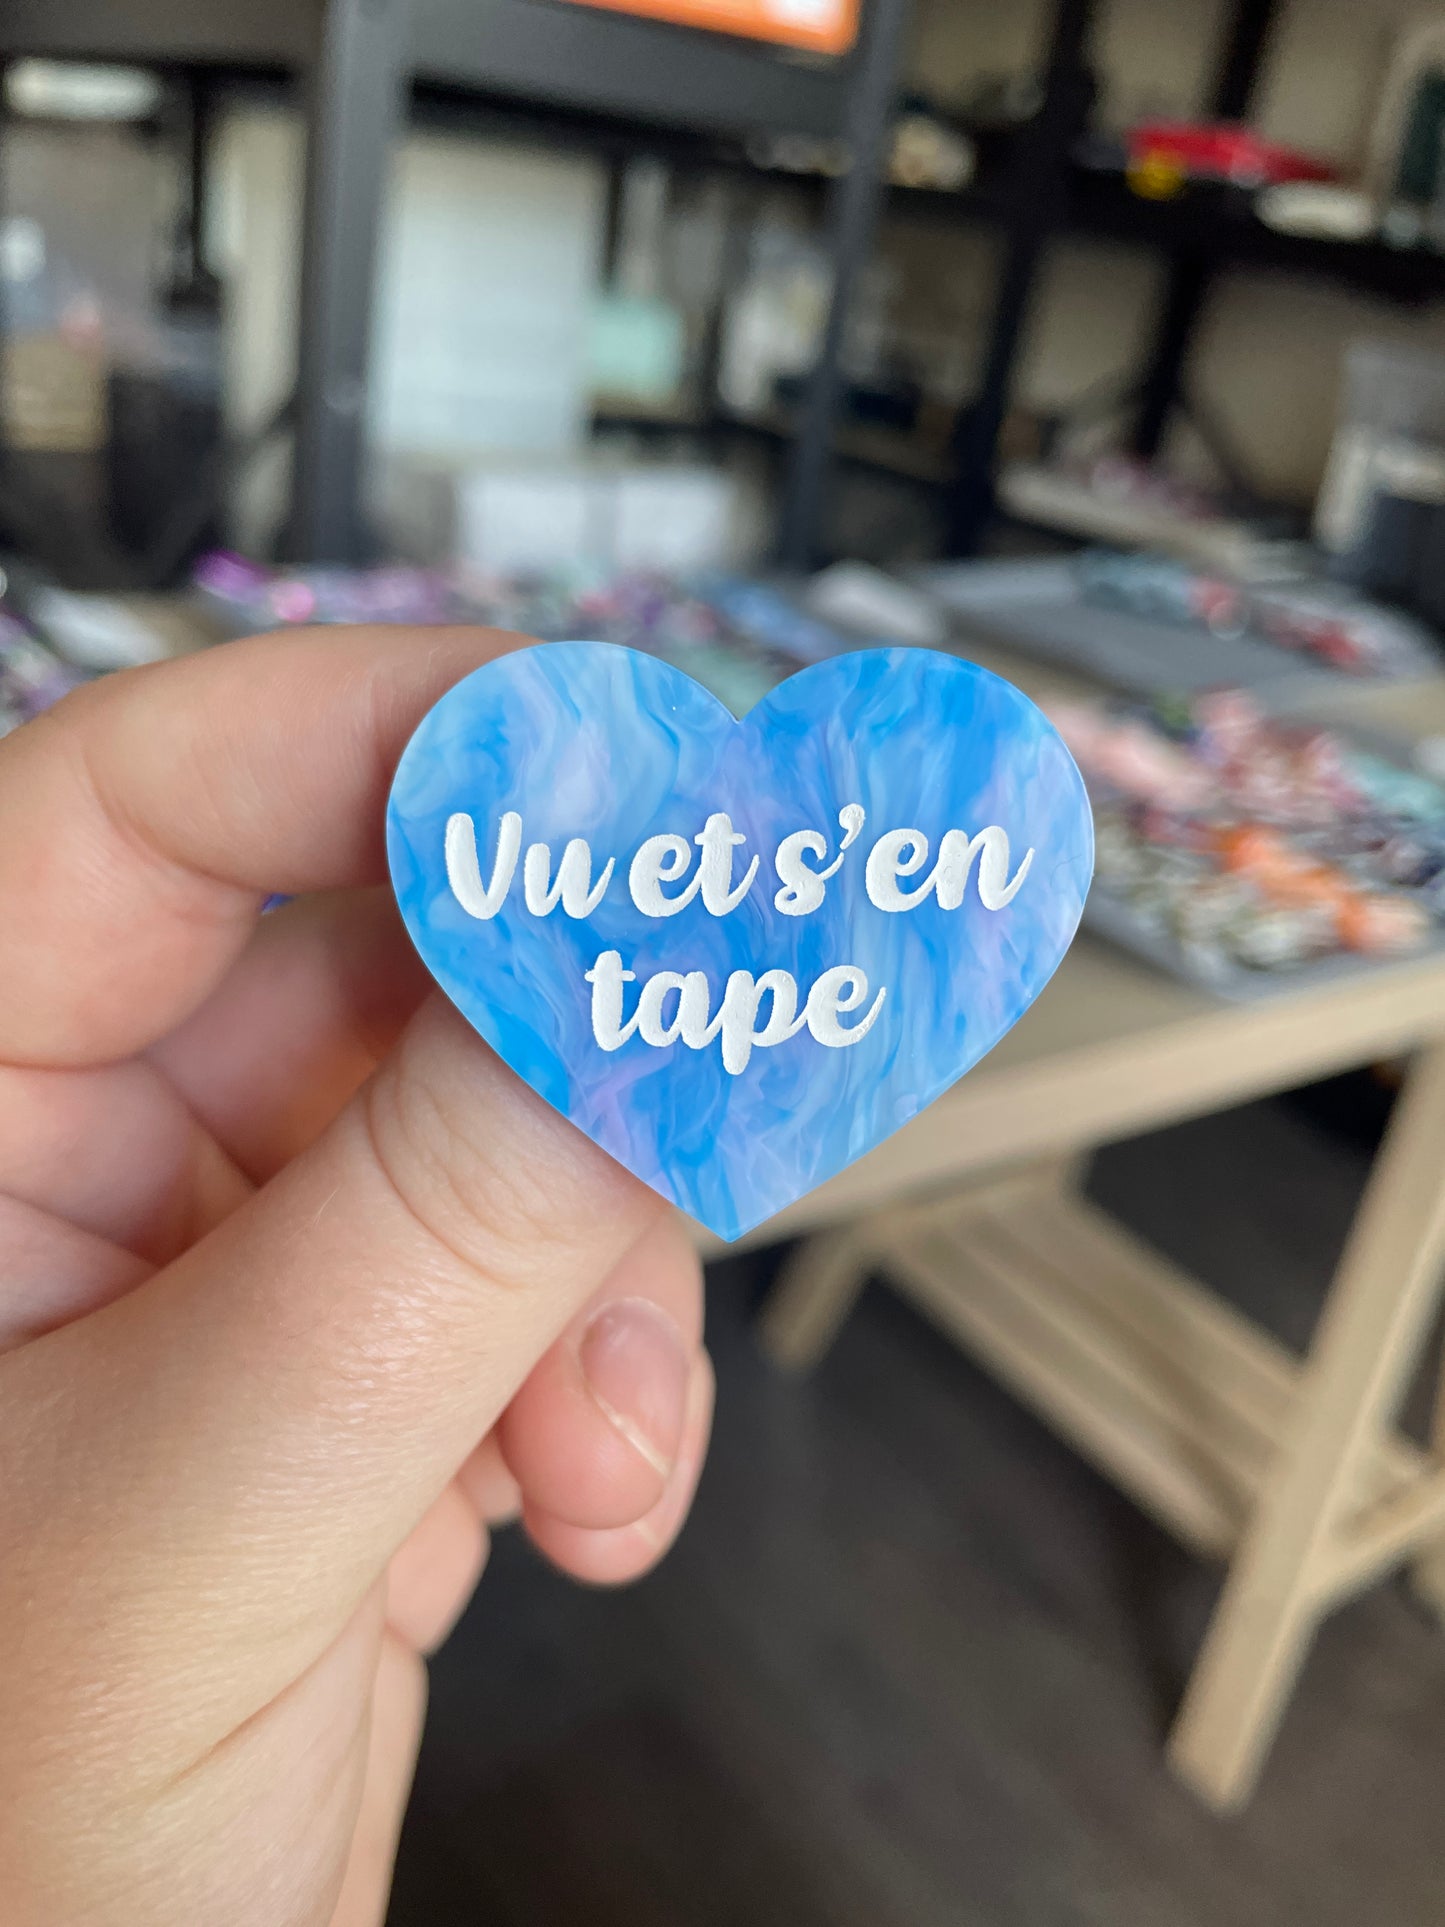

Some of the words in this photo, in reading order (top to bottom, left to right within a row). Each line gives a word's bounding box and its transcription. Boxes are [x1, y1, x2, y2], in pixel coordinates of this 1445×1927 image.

[445, 811, 616, 920] Vu
[628, 812, 760, 917] et
[773, 803, 1036, 917] s'en
[584, 949, 887, 1076] tape
